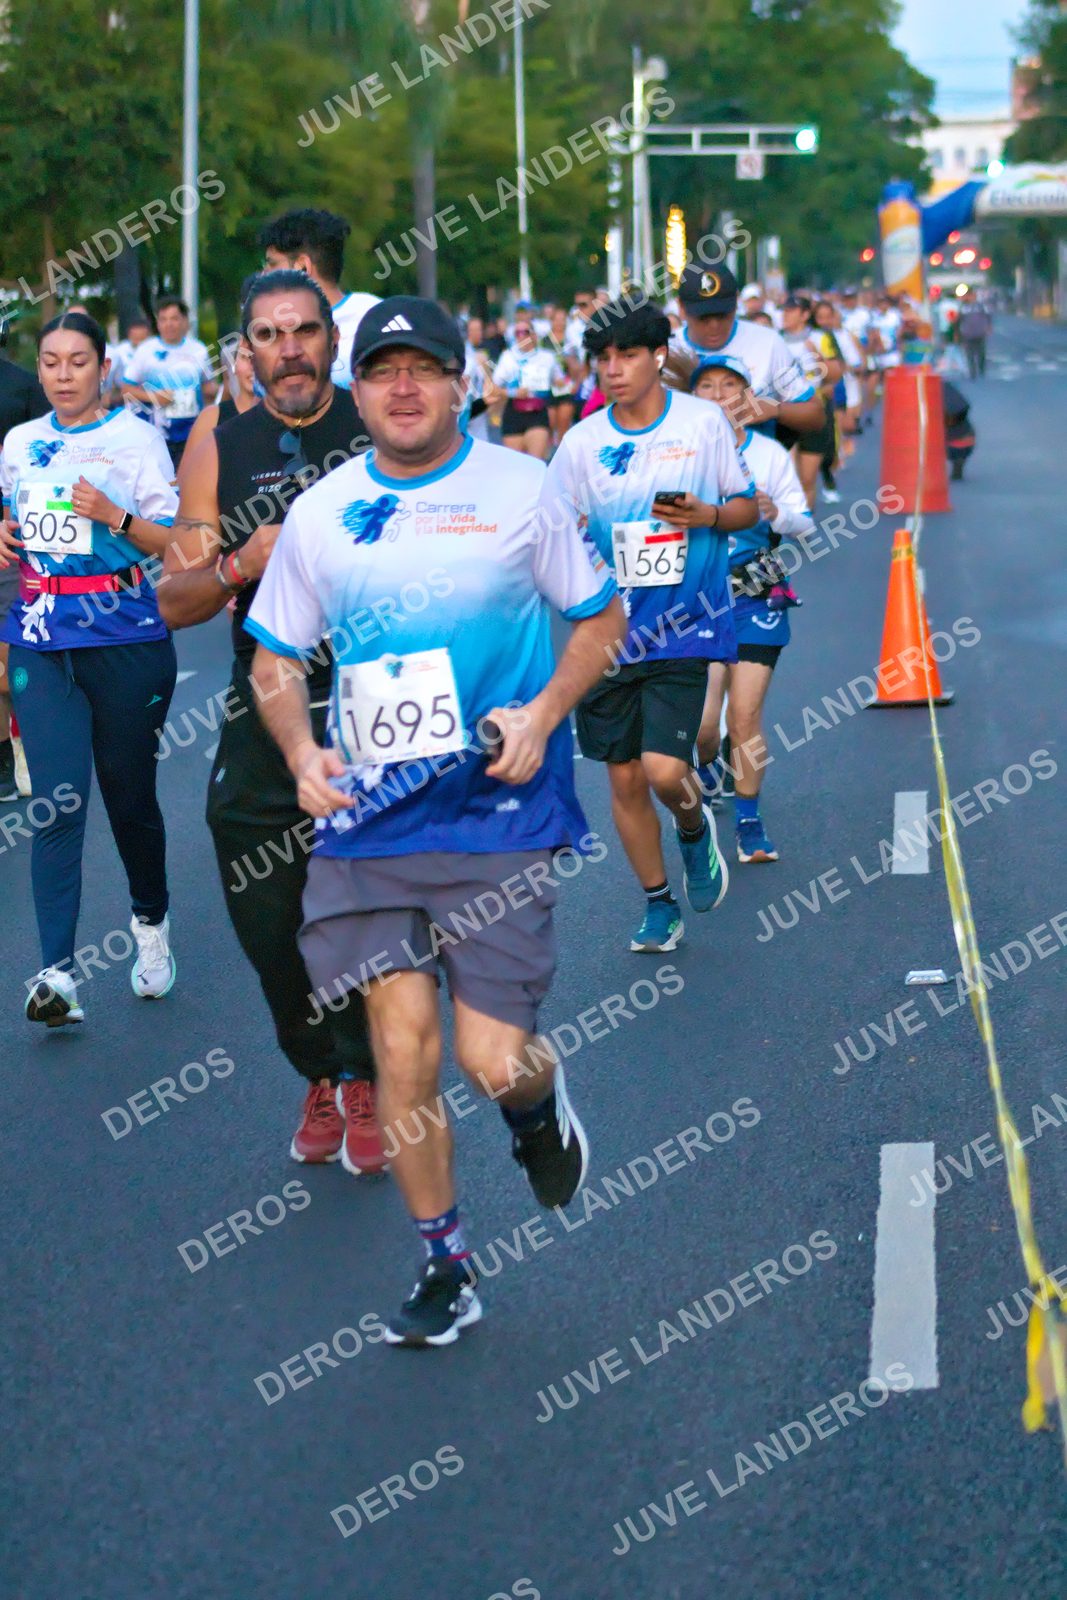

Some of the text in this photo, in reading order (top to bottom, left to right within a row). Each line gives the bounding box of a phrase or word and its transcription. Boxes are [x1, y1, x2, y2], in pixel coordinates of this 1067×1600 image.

[258, 484, 282, 494] RIZO
[416, 502, 476, 513] Carrera
[22, 512, 78, 544] 505
[415, 515, 433, 525] por
[450, 514, 476, 523] Vida
[619, 545, 687, 577] 1565
[346, 694, 456, 752] 1695
